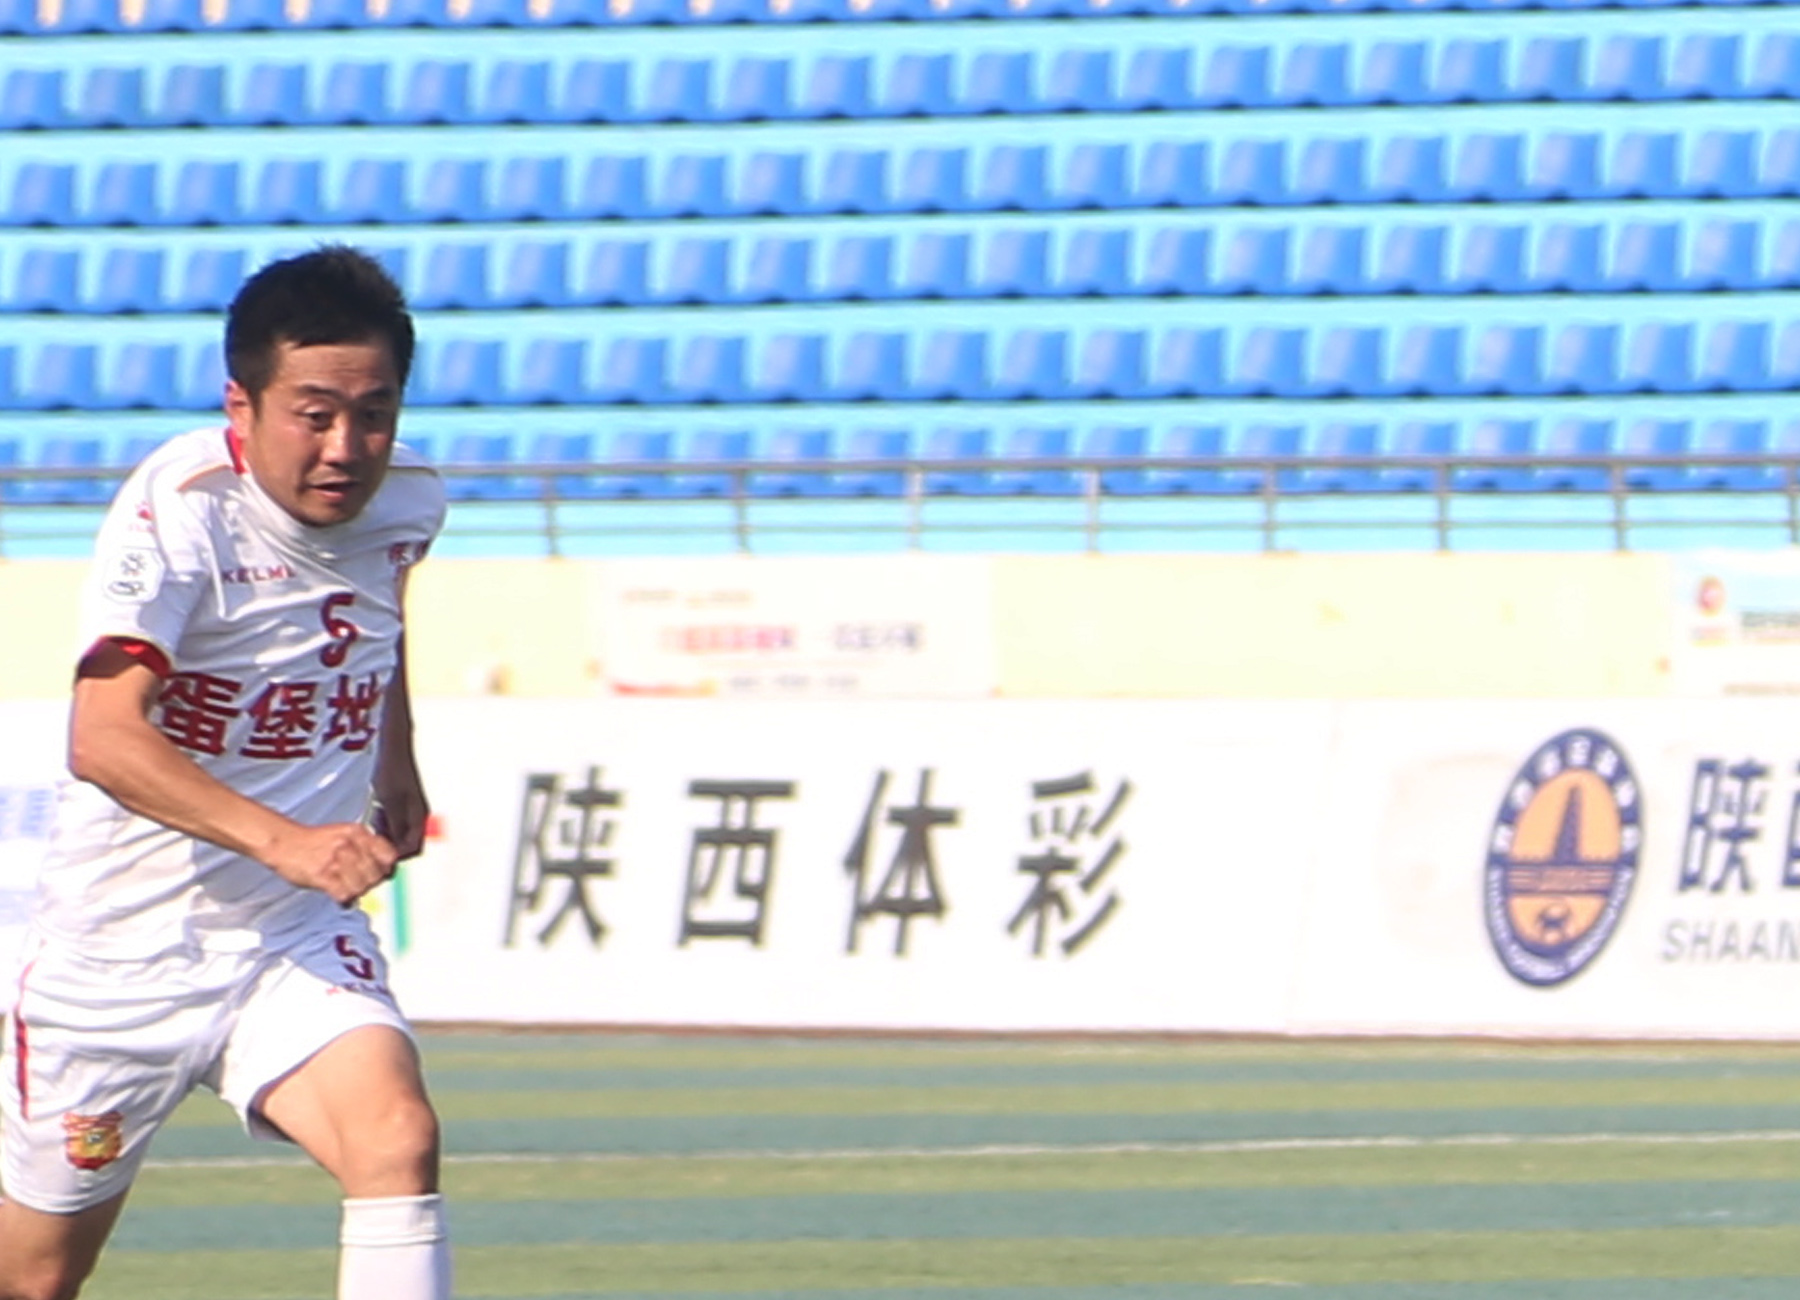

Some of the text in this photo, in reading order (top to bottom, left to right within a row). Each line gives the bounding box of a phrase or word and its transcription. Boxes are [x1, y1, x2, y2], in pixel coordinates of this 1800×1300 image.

[320, 592, 358, 668] 5
[502, 765, 1136, 957] 陕西体彩
[333, 933, 376, 981] 5
